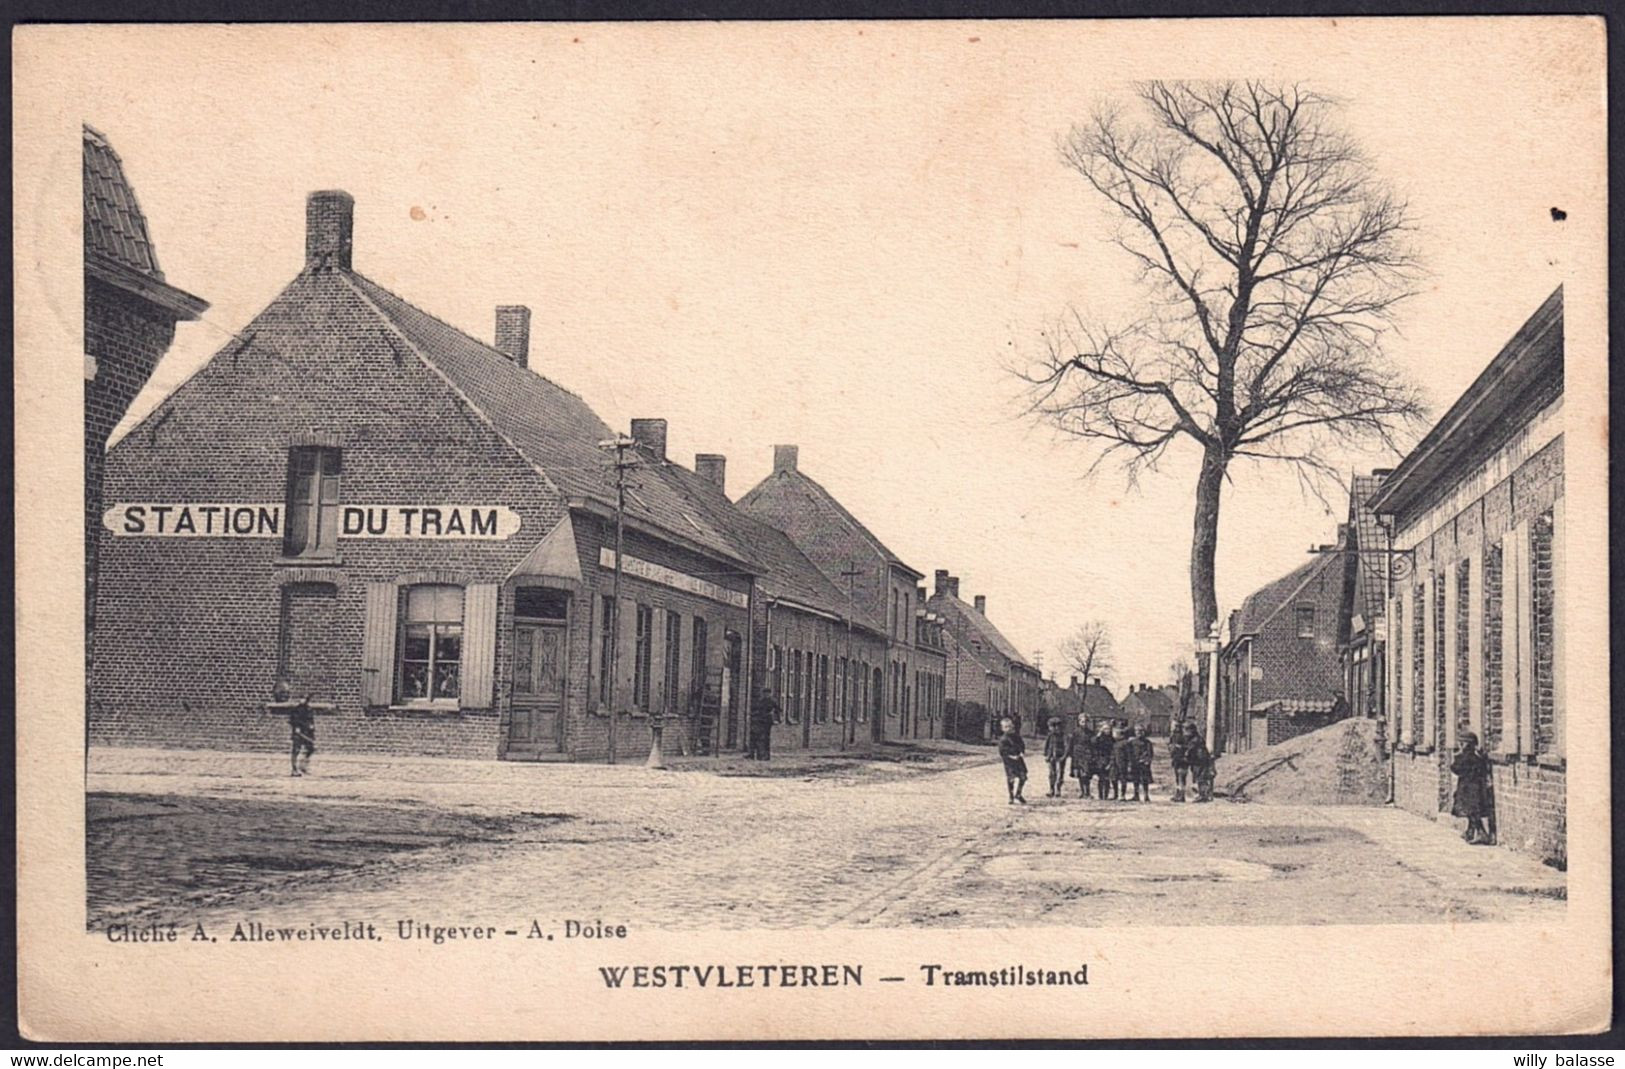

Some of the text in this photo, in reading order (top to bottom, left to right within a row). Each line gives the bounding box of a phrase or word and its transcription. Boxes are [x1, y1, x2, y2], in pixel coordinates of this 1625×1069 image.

[123, 505, 498, 537] STATION DU TRAM
